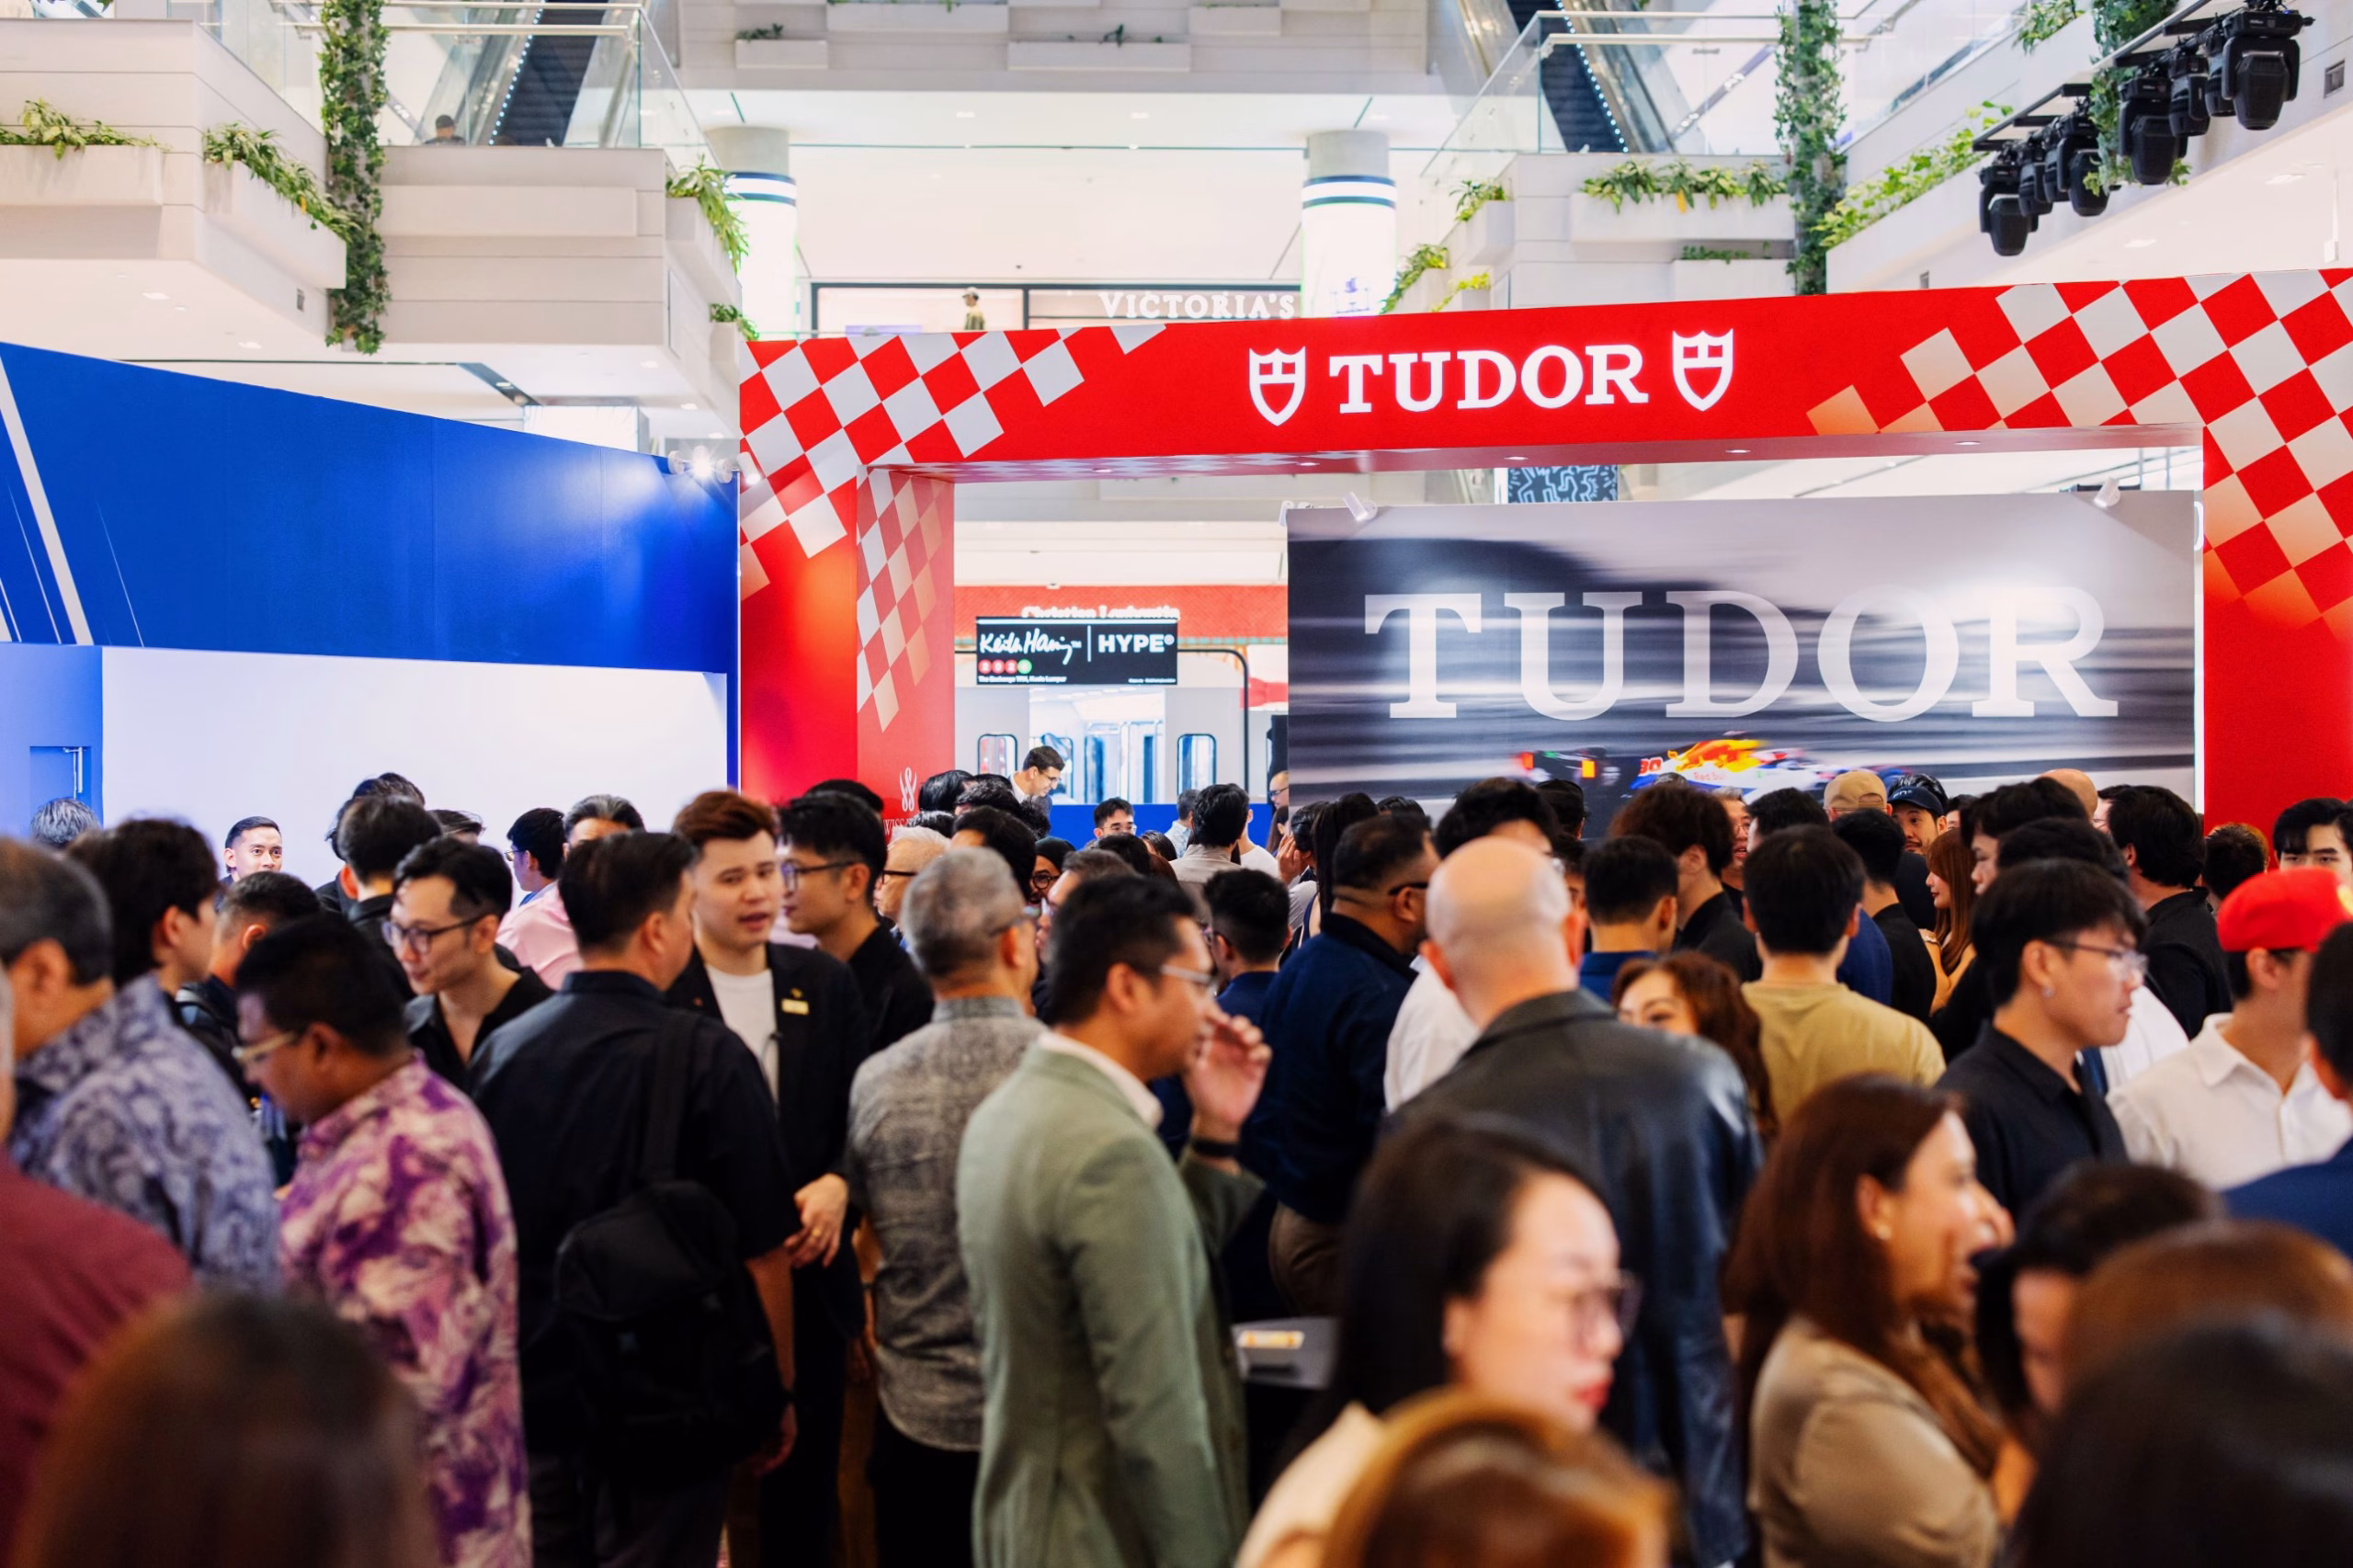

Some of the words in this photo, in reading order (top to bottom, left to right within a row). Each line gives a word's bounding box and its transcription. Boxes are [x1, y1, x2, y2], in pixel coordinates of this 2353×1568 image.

[1098, 291, 1295, 319] VICTORIA'S
[1329, 344, 1649, 414] TUDOR
[1364, 585, 2120, 722] TUDOR
